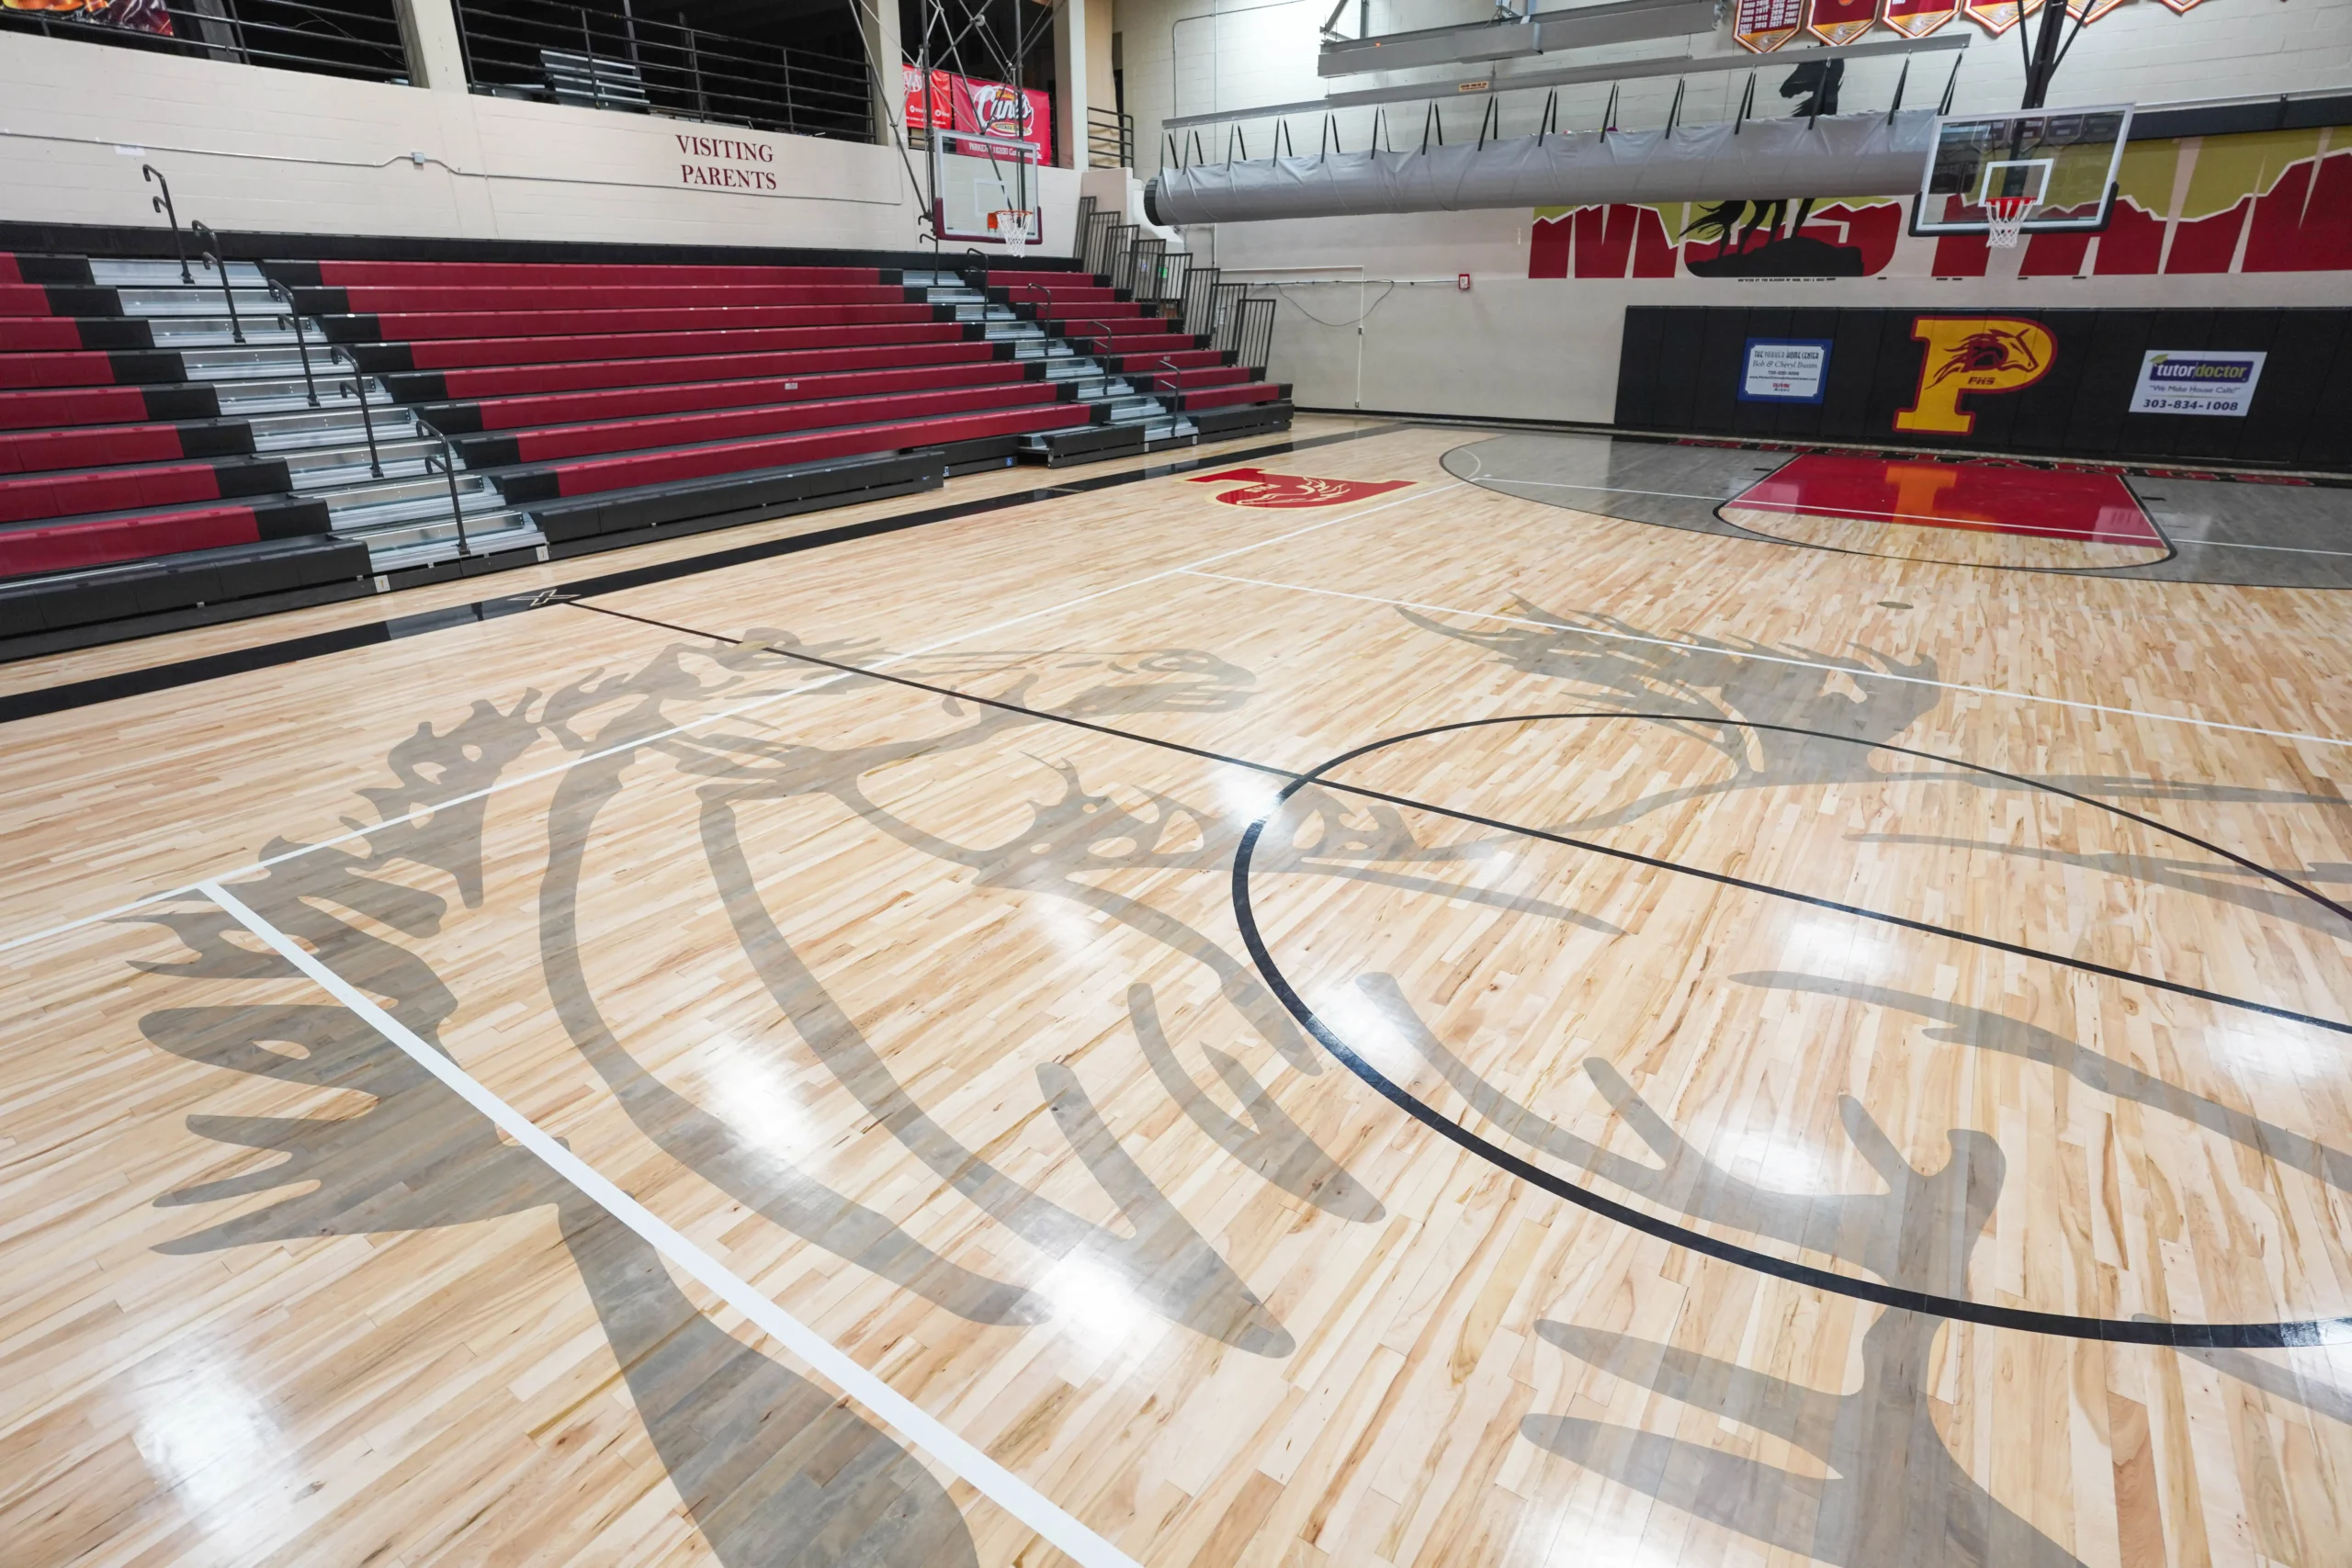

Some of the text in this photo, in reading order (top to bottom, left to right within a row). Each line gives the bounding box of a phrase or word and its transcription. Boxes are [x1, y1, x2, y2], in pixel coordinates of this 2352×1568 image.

[675, 134, 774, 163] VISITING
[680, 164, 776, 190] PARENTS
[1775, 360, 1795, 369] Cheryl
[1892, 316, 2058, 435] P
[1967, 377, 1996, 385] PHS
[2143, 399, 2239, 411] 303-834-1008
